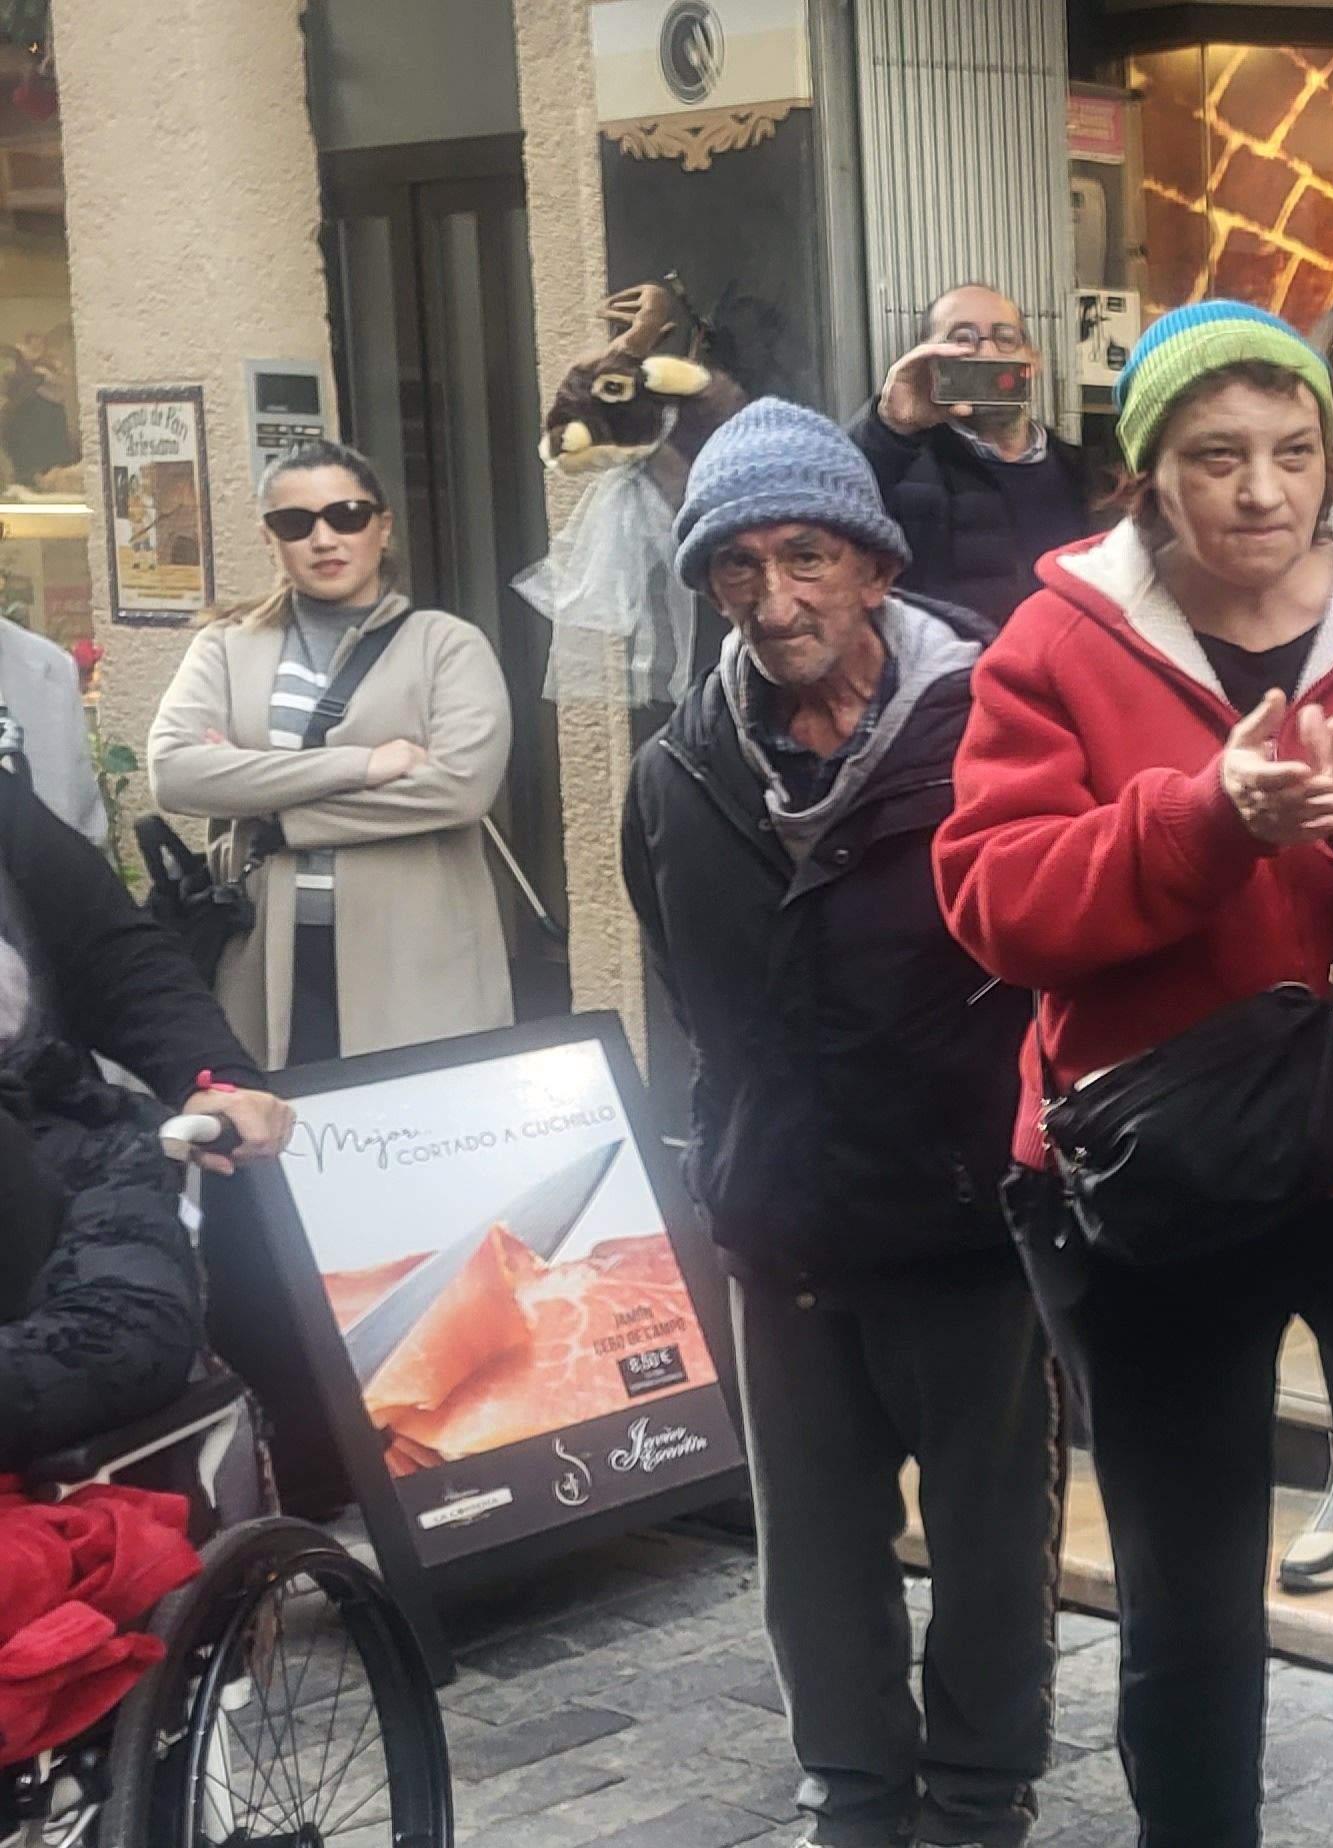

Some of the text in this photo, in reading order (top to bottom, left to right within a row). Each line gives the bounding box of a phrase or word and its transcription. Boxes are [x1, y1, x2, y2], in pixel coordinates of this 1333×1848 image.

[397, 1104, 617, 1166] CORTADO A CUCHILLO
